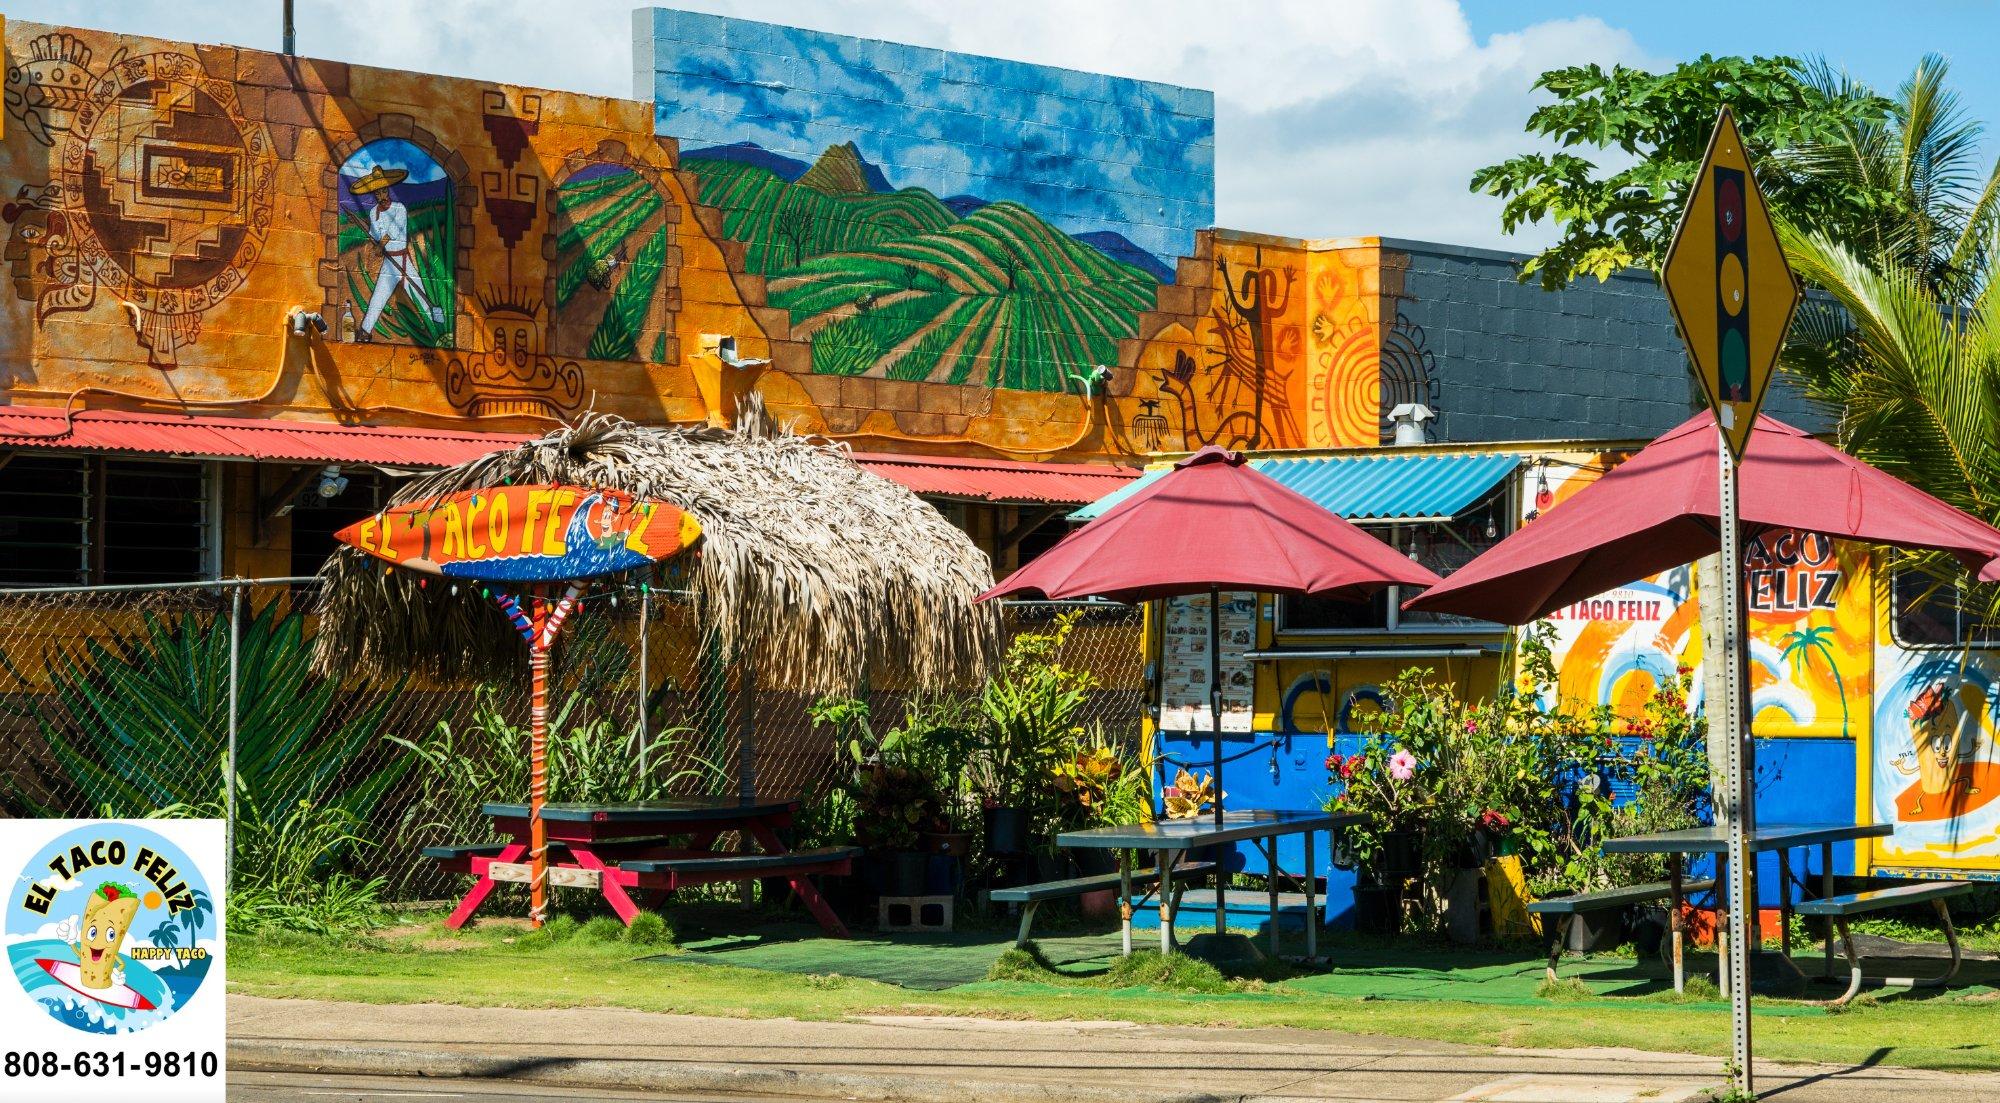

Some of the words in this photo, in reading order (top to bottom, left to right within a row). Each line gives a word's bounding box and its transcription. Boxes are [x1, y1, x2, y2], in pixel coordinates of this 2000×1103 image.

[360, 516, 398, 559] EL
[1743, 529, 1833, 569] ACO
[1570, 600, 1614, 620] TACO
[1619, 600, 1661, 620] FELIZ
[1744, 568, 1843, 613] ELIZ
